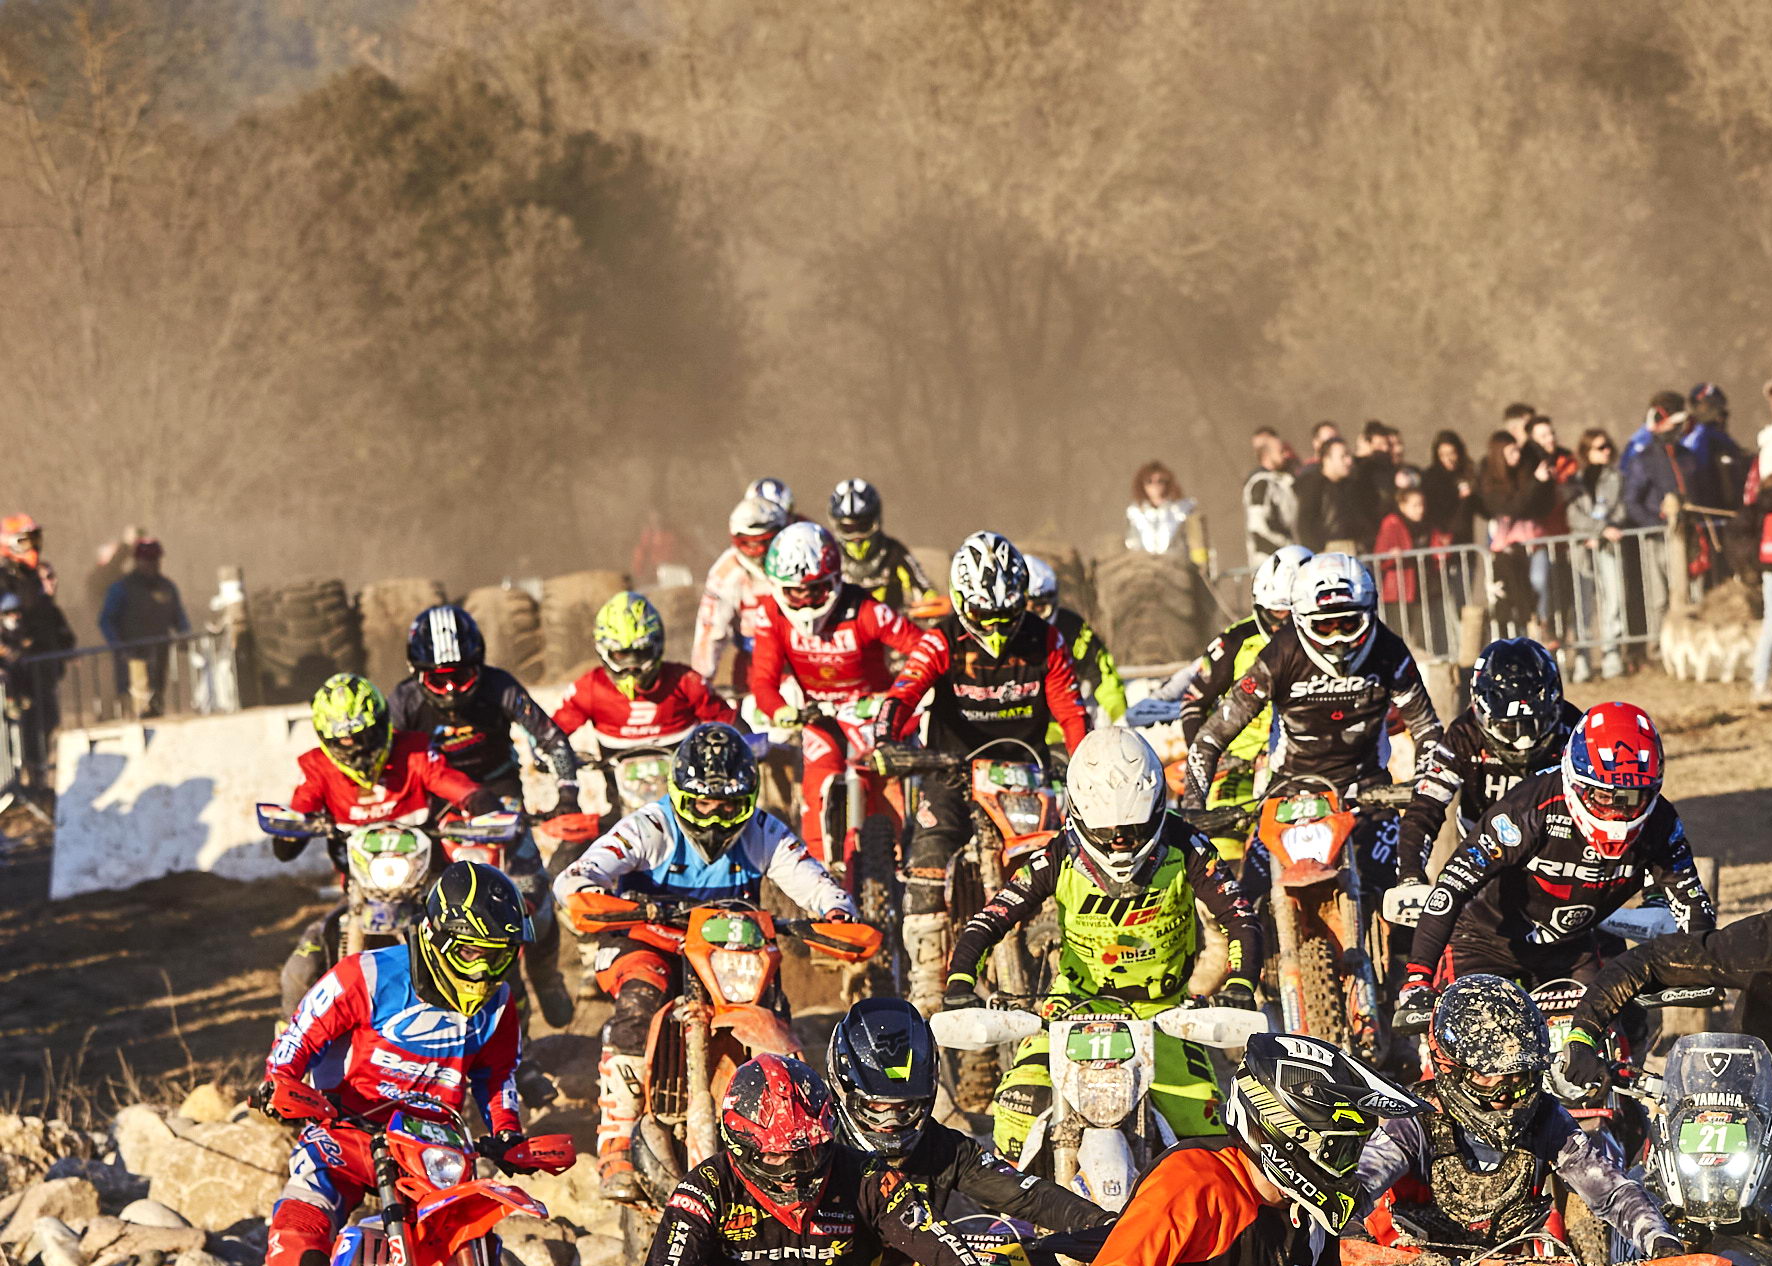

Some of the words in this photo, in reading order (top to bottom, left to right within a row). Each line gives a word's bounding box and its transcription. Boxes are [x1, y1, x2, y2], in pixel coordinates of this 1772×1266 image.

[1291, 801, 1318, 818] 28
[728, 922, 743, 941] 3
[1121, 948, 1156, 959] Ibiza
[1088, 1035, 1111, 1059] 11
[371, 1047, 462, 1087] Beta
[1692, 1093, 1743, 1107] YAMAHA
[1697, 1125, 1727, 1153] 21
[1260, 1142, 1328, 1206] AVIATOR
